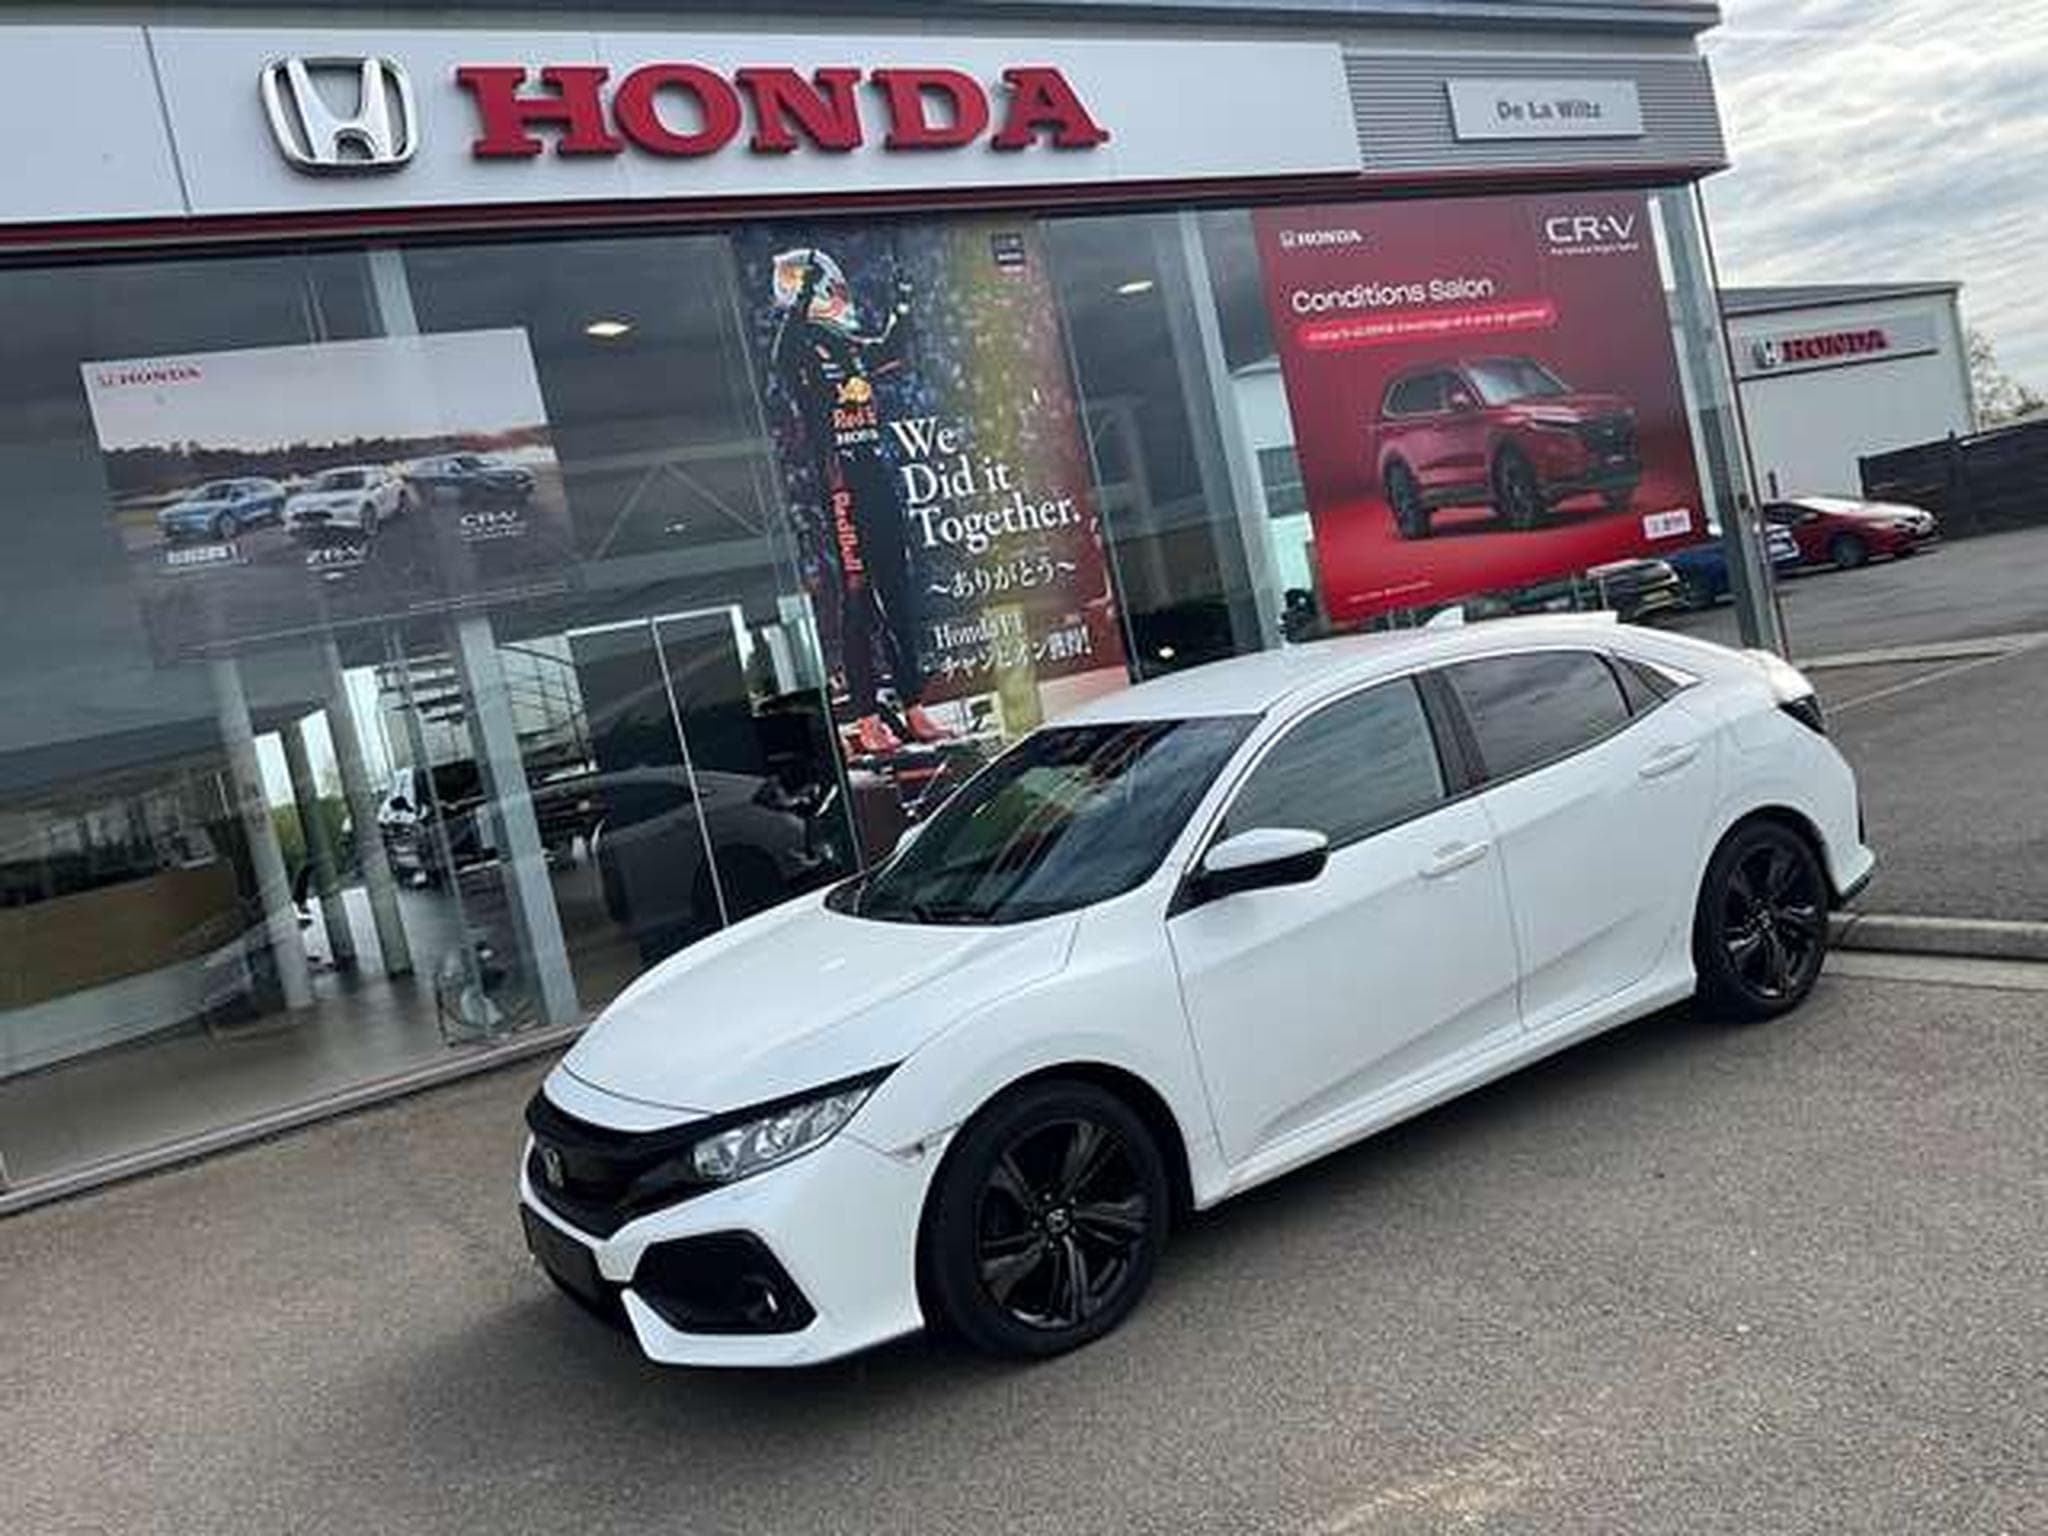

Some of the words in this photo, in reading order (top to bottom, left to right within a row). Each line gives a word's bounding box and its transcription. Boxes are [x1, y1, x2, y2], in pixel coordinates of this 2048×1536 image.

[456, 63, 1110, 157] HONDA
[1496, 101, 1524, 119] De
[1528, 101, 1552, 119] La
[1298, 229, 1363, 246] HONDA
[1291, 282, 1426, 313] Conditions
[1429, 277, 1494, 300] Salon
[1780, 329, 1887, 362] HONDA
[119, 367, 203, 386] HONDA
[889, 416, 958, 458] We
[900, 453, 977, 505] Did
[984, 455, 1012, 494] it
[908, 491, 1082, 555] Together.
[932, 616, 999, 649] Honda
